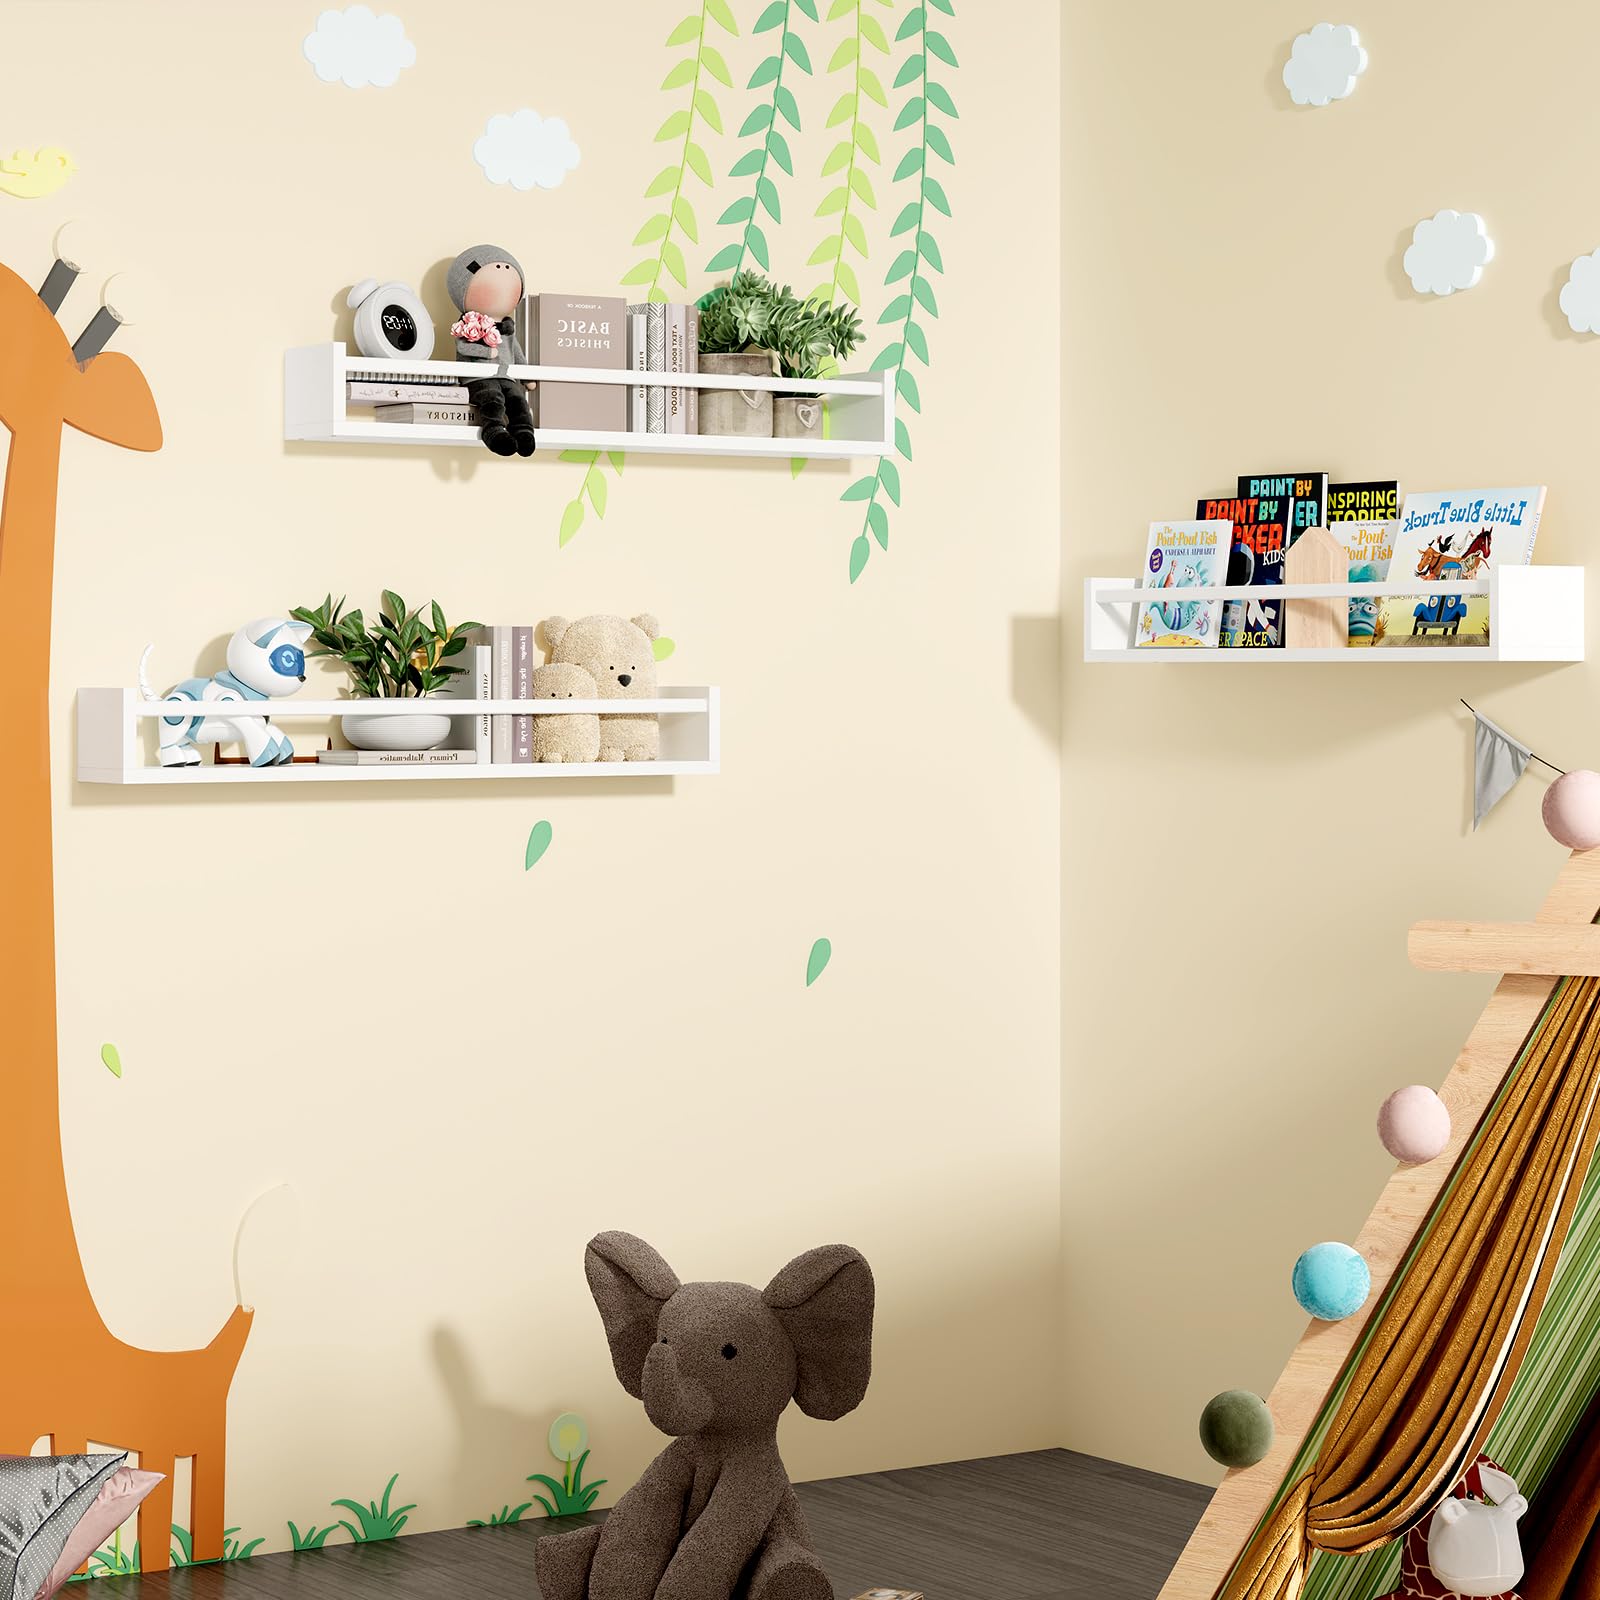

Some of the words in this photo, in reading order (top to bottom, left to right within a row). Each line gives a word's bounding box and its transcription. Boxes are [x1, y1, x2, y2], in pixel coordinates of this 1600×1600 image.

[1250, 478, 1295, 497] PAINT
[1296, 479, 1312, 496] BY
[1328, 490, 1396, 509] NSPIRING
[1205, 499, 1258, 523] PAINT
[1258, 500, 1279, 520] BY
[1200, 531, 1217, 545] Fish
[1263, 547, 1285, 566] KIDS
[1370, 543, 1393, 561] Fish
[1234, 632, 1268, 647] SPACE
